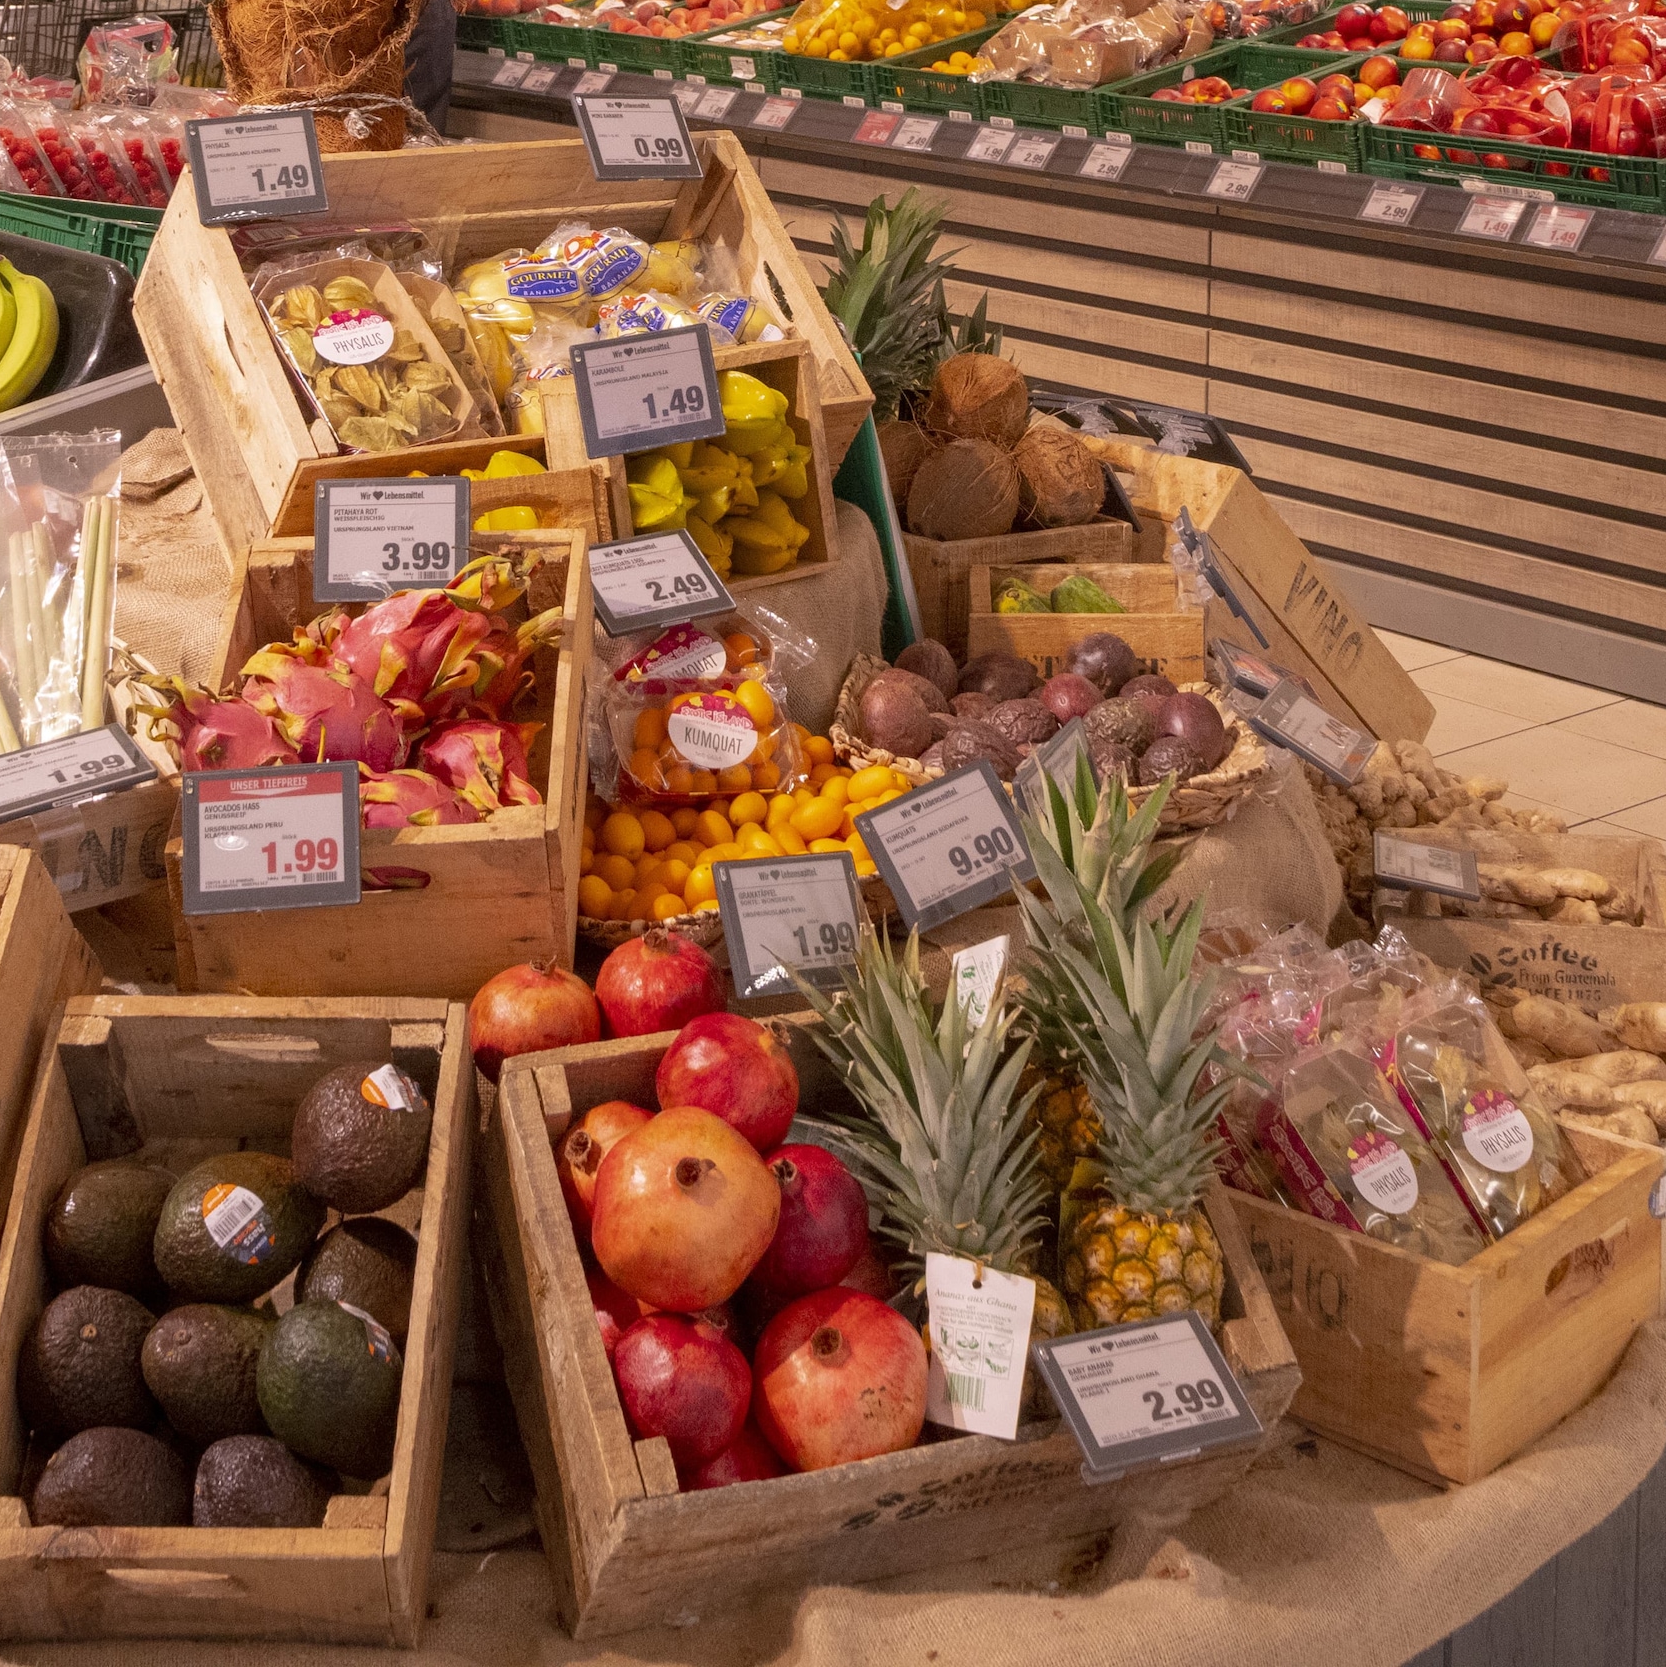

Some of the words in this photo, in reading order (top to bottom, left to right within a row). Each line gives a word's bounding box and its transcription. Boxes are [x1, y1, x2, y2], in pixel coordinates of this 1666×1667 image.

[634, 137, 683, 157] 0.99
[906, 135, 927, 148] 2.49
[207, 150, 250, 159] URSPRUNGSLAND
[984, 146, 1003, 159] 1.99
[1023, 152, 1045, 165] 2.99
[1097, 163, 1119, 176] 2.99
[252, 164, 309, 192] 1.49
[1224, 182, 1249, 195] 2.99
[1382, 205, 1408, 219] 2.99
[1483, 219, 1508, 233] 1.49
[1550, 229, 1576, 244] 1.49
[510, 270, 573, 286] GOURMET
[600, 260, 637, 291] BANANAS
[523, 285, 567, 297] BANANAS
[333, 332, 385, 353] PHYSALIS
[612, 350, 622, 358] Wir
[592, 365, 624, 376] KARAMBOLE
[641, 370, 669, 378] MALAYSIA
[642, 385, 704, 419] 1.49
[360, 492, 371, 500] Wir
[382, 541, 451, 571] 3.99
[645, 573, 707, 602] 2.49
[1283, 561, 1365, 669] VINO
[681, 706, 713, 722] EXOTIC
[713, 710, 753, 730] ISLAND
[684, 727, 743, 755] KUMQUAT
[48, 754, 126, 784] 1.99
[230, 779, 259, 791] UNSER
[262, 776, 308, 788] TIEFPREIS
[204, 804, 241, 813] AVOCADOS
[242, 802, 260, 811] HASS
[899, 807, 913, 819] Wir
[204, 812, 247, 820] GENUSSREIF
[204, 822, 264, 833] URSPRUNGSLAND
[265, 821, 284, 829] PERU
[886, 826, 917, 844] KUMQUATS
[892, 830, 940, 855] URSPRUNGSLAND
[938, 815, 970, 835] SÜDAFRIKA
[261, 837, 339, 874] 1.99
[948, 826, 1015, 876] 9.90
[758, 872, 769, 881] Wir
[793, 921, 856, 957] 1.99
[1497, 942, 1598, 971] Coffee
[1519, 969, 1550, 984] From
[1556, 970, 1616, 987] Guatemala
[1567, 989, 1602, 1002] 1875
[1480, 1125, 1528, 1158] PHYSALIS
[1369, 1166, 1413, 1199] PHYSALIS
[934, 1288, 966, 1300] Ananas
[967, 1294, 984, 1304] aus
[986, 1296, 1018, 1311] Ghana
[1087, 1344, 1101, 1355] Wir
[1068, 1365, 1086, 1376] BABY
[1086, 1360, 1114, 1371] ANANAS
[1136, 1370, 1161, 1380] GHANA
[1080, 1389, 1104, 1399] KLASSE
[1142, 1378, 1225, 1422] 2.99
